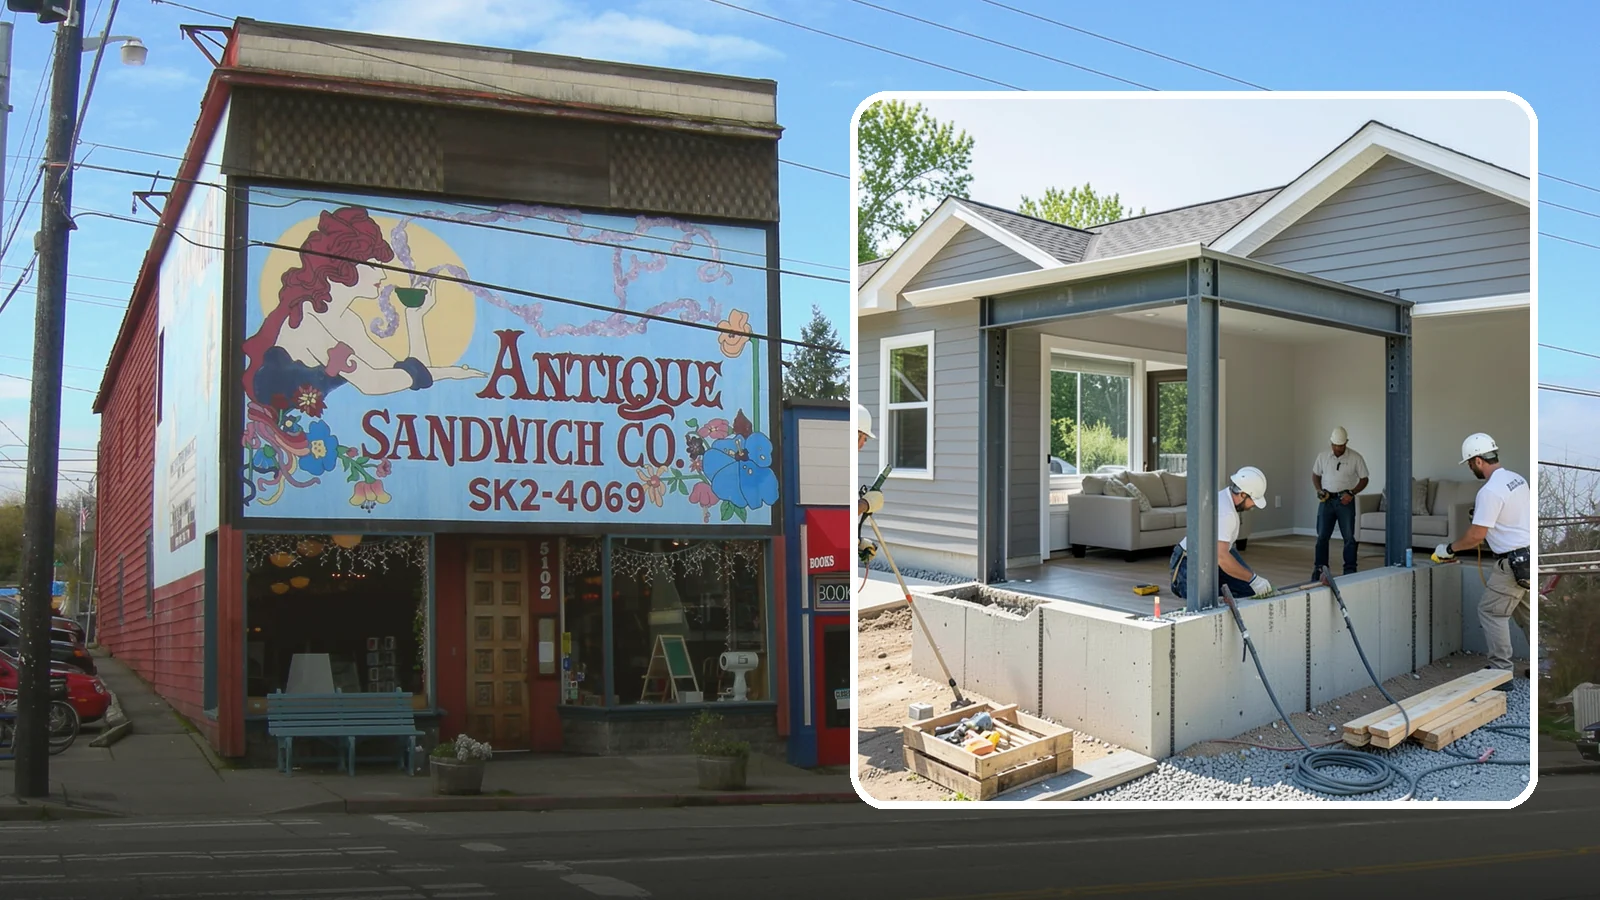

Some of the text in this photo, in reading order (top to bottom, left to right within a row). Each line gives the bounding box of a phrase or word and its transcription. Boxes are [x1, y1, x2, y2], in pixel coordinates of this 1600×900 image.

[476, 329, 723, 420] ANTIQUE
[361, 408, 685, 468] SANDWICH CO.
[468, 477, 646, 513] SK2-4069
[539, 541, 552, 600] 5102
[809, 555, 834, 569] BOOKS
